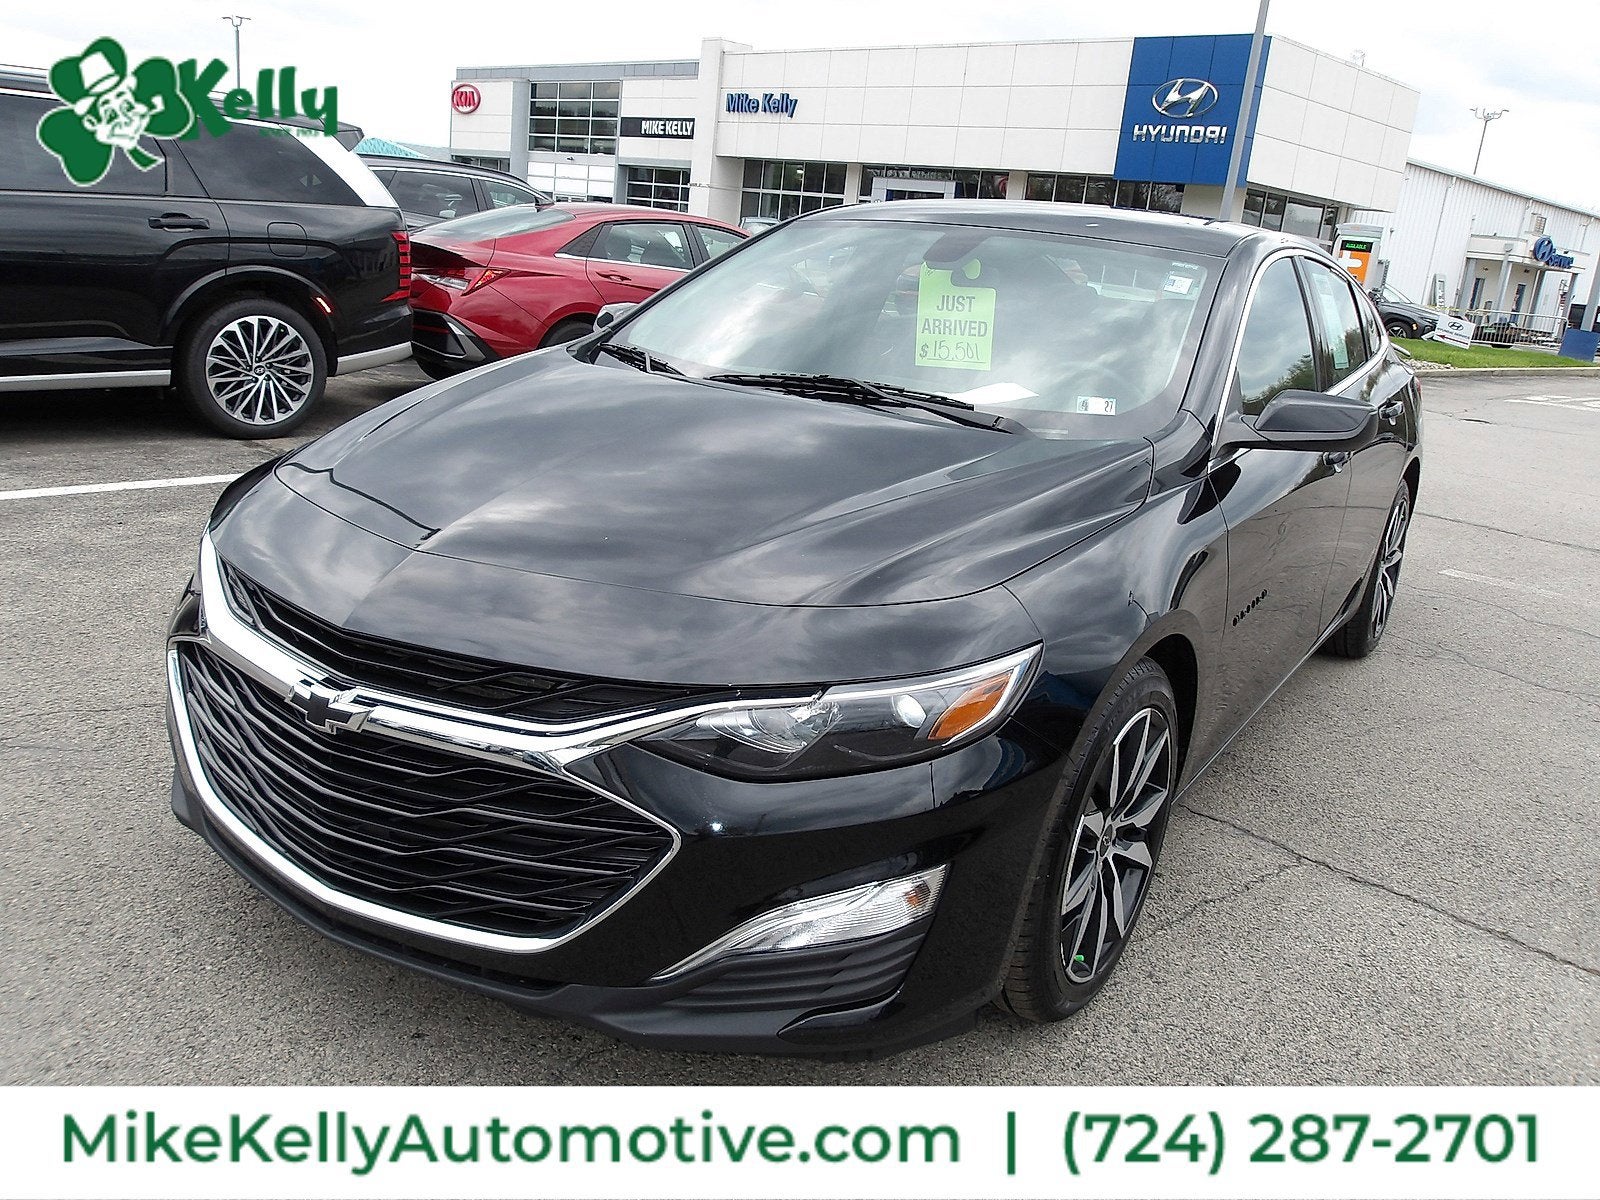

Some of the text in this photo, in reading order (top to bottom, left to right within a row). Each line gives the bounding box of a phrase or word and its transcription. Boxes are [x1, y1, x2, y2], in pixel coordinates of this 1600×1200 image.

[453, 90, 477, 107] KIA
[726, 93, 797, 118] Mike Kelly
[641, 119, 693, 136] MIKE KELLY
[1133, 124, 1228, 144] HYUNDAI
[937, 295, 976, 312] JUST
[921, 318, 988, 338] ARRIVED
[1104, 400, 1113, 412] 27
